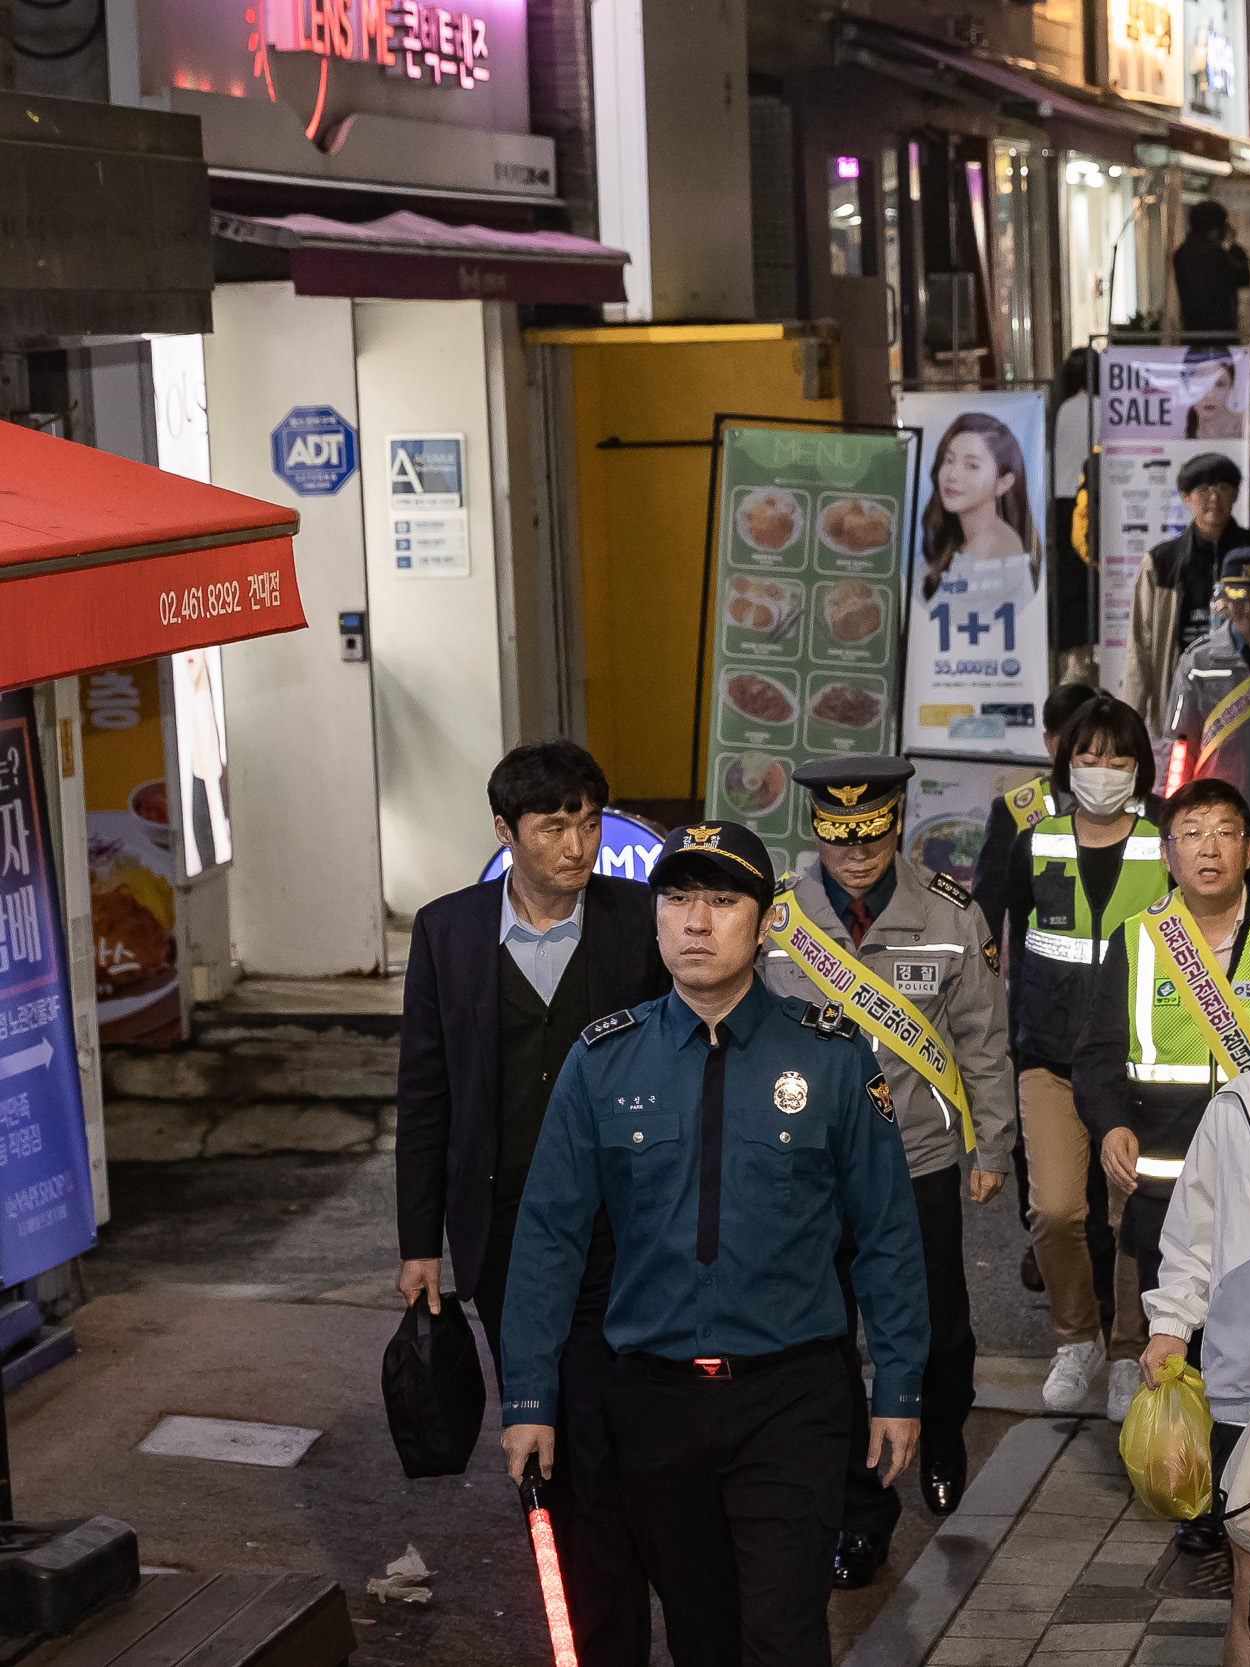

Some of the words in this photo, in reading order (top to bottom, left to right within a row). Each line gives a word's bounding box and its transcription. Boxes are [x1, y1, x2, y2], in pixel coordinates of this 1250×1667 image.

[298, 0, 353, 60] LENS
[361, 0, 396, 66] ME
[402, 0, 490, 89] 콘택트렌즈
[1108, 397, 1172, 426] SALE
[286, 433, 344, 467] ADT
[773, 438, 862, 469] MENU
[159, 580, 242, 626] 02.461.8292
[247, 569, 281, 611] 건대점
[930, 602, 1015, 653] 1+1
[898, 983, 934, 991] POLICE
[899, 965, 934, 981] 경찰
[1158, 915, 1209, 985] 안전하고
[1192, 978, 1237, 1034] 건전한
[789, 926, 855, 994] 범죄없는
[850, 983, 923, 1047] 건대맛의
[918, 1036, 948, 1075] 거리
